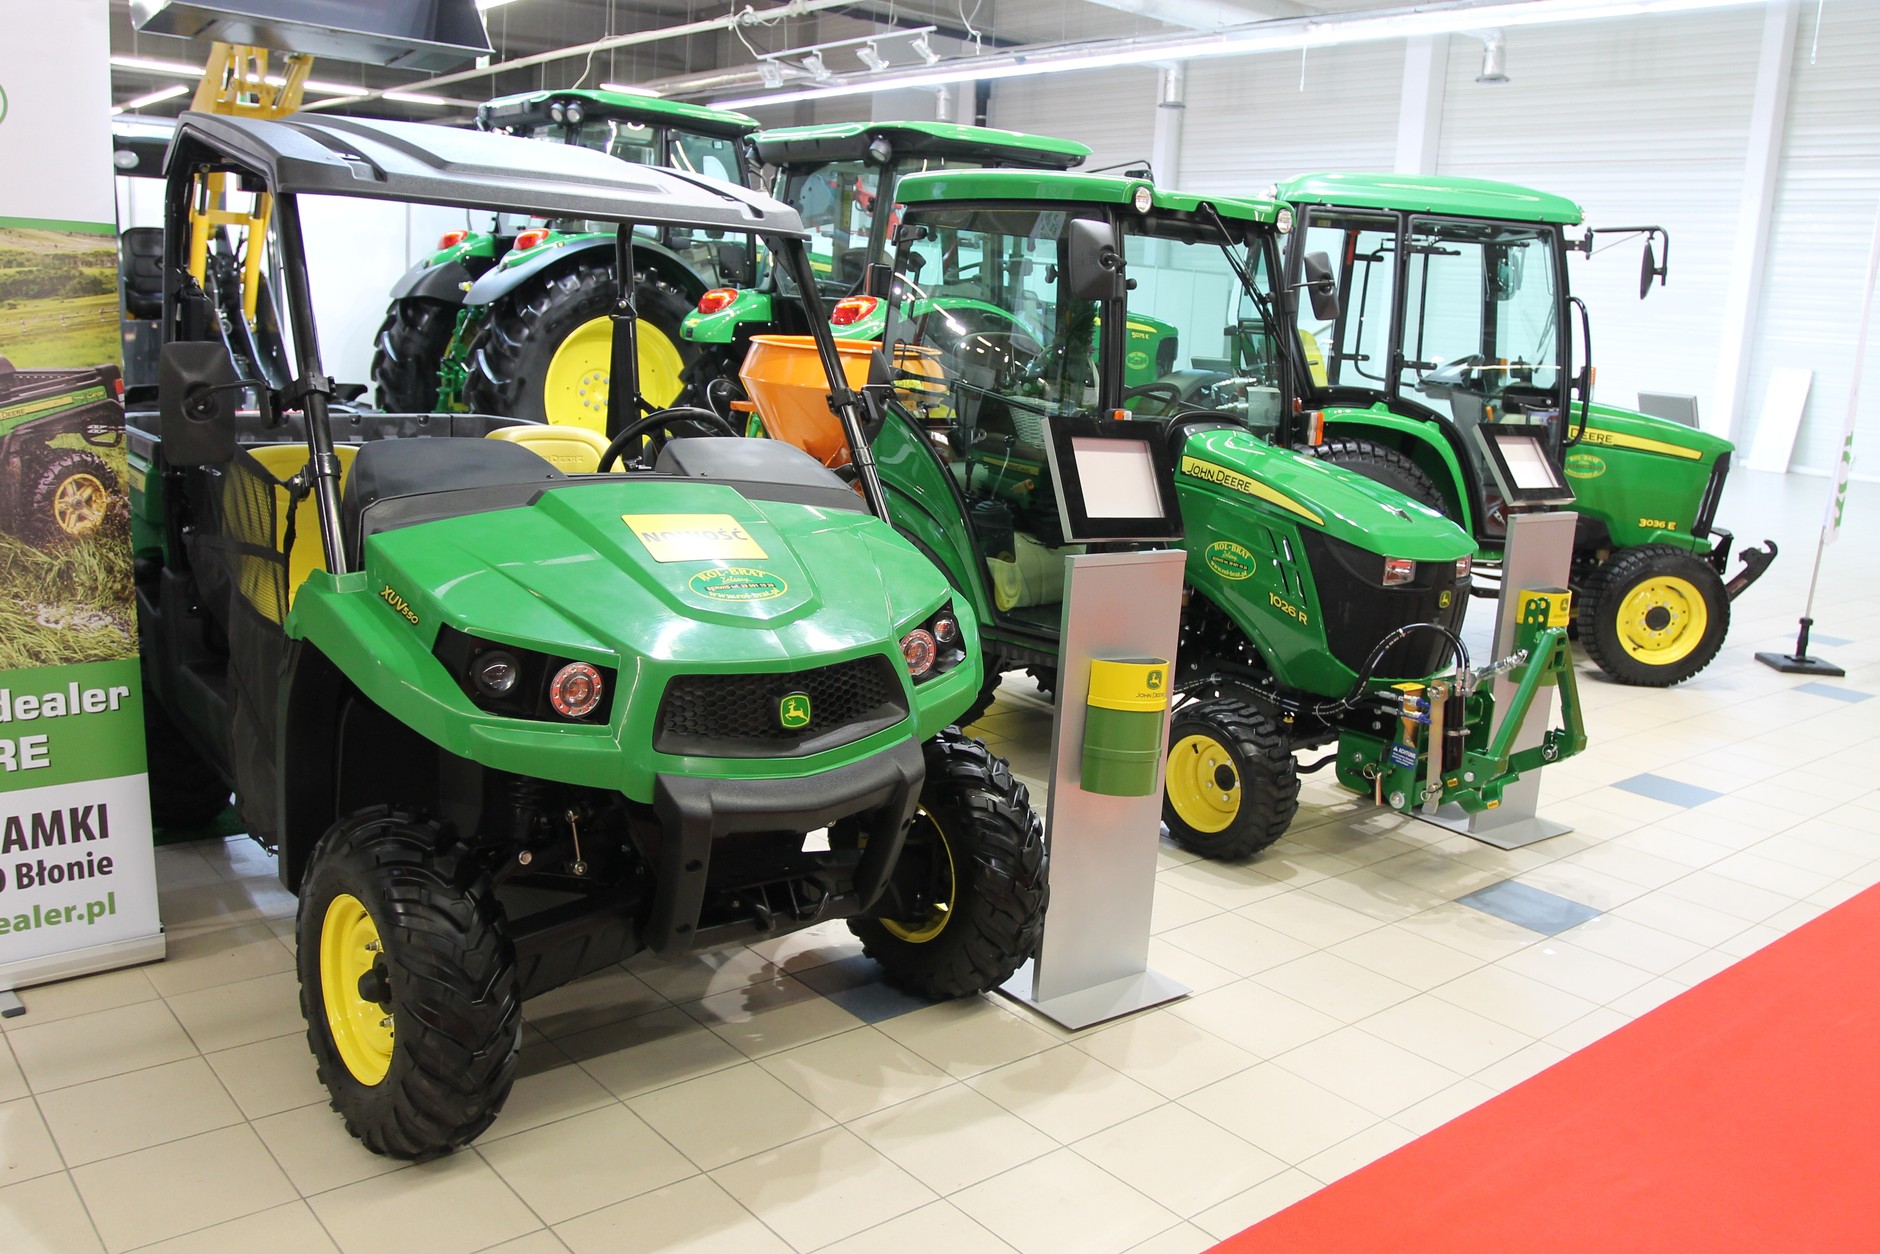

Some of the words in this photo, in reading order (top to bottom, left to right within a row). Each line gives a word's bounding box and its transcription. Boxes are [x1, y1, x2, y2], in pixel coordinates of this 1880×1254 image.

[1187, 462, 1216, 481] JOHN
[1215, 470, 1252, 493] DEERE
[380, 584, 419, 624] XUV550
[1269, 591, 1297, 618] 1026
[1298, 610, 1308, 626] R
[1, 803, 109, 854] AMKI
[15, 851, 114, 890] Błonie
